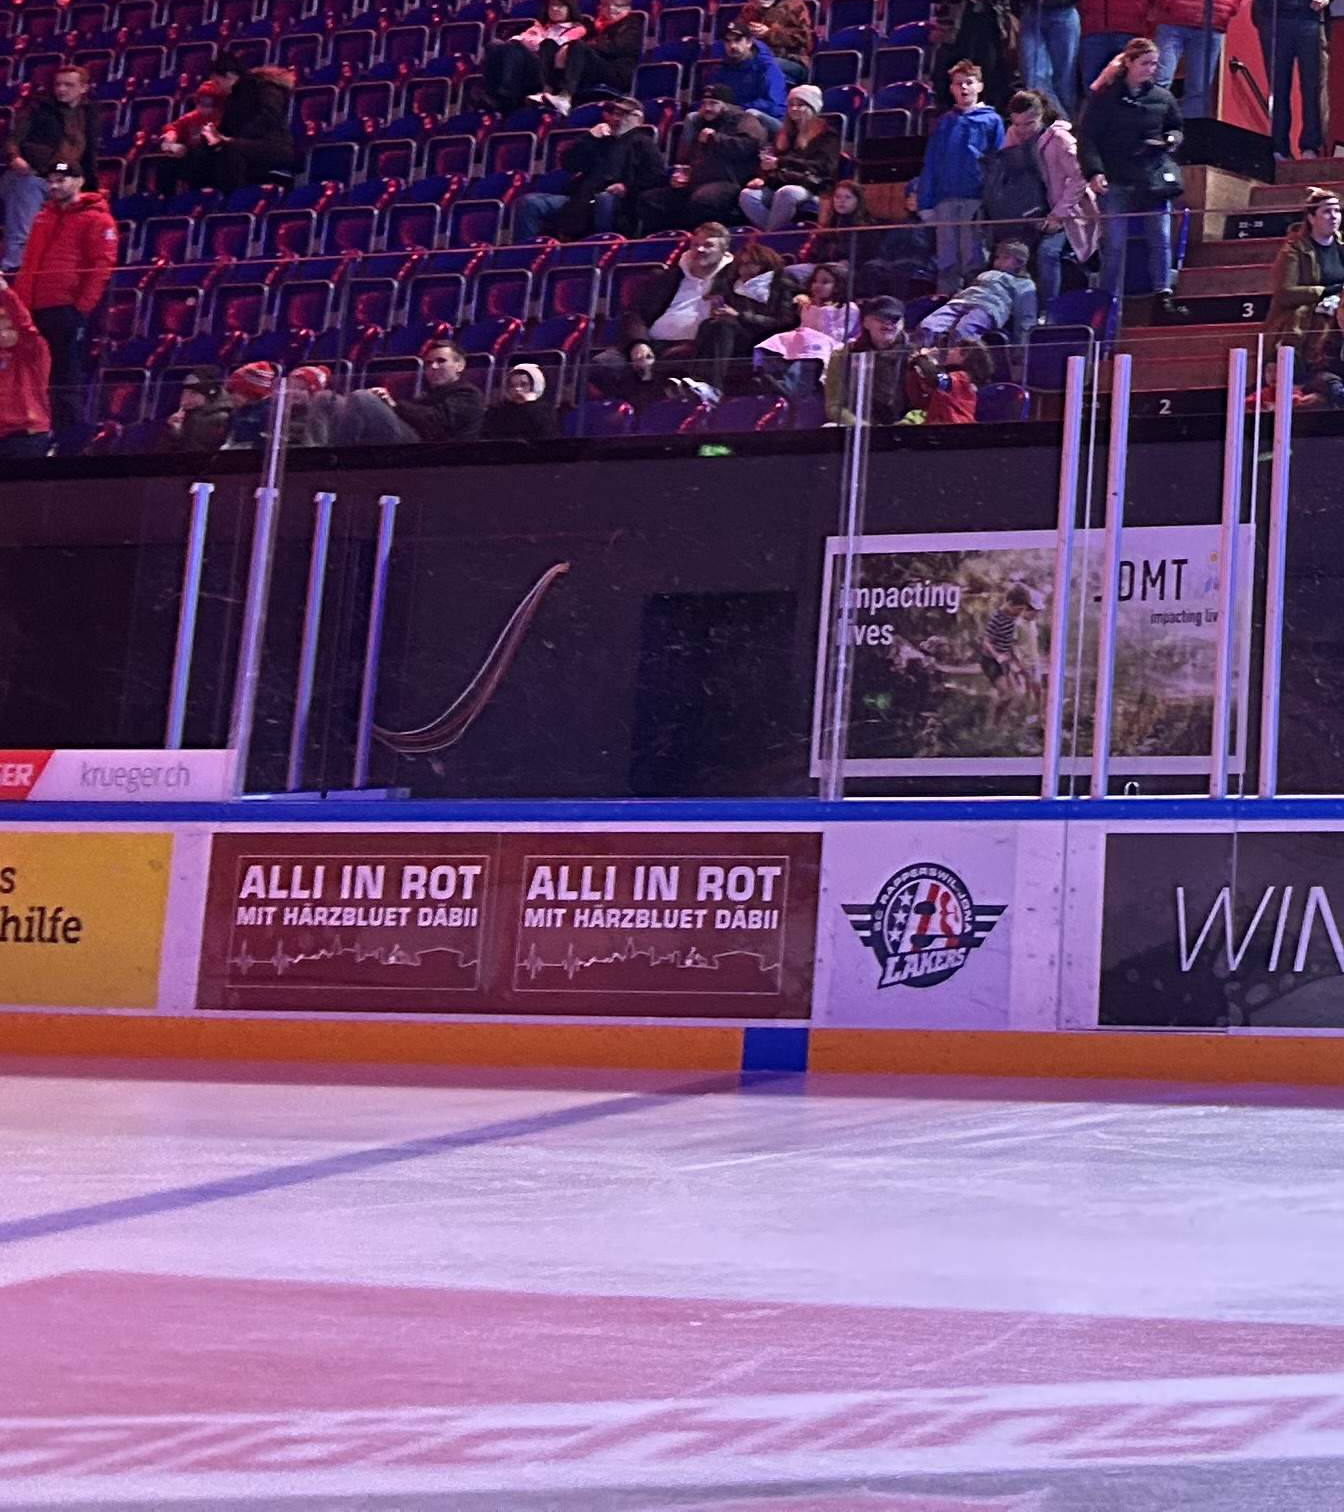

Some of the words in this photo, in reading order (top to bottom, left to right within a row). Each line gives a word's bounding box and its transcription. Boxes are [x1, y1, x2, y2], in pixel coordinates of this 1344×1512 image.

[1241, 302, 1255, 318] 3
[1158, 399, 1172, 415] 2
[238, 864, 326, 900] ALLI
[339, 864, 386, 900] IN
[400, 864, 483, 901] ROT
[526, 865, 618, 901] ALLI
[633, 865, 680, 901] IN
[696, 865, 782, 902] ROT
[235, 906, 277, 926] MIT
[523, 907, 567, 928] MIT
[879, 947, 966, 987] LAKERS
